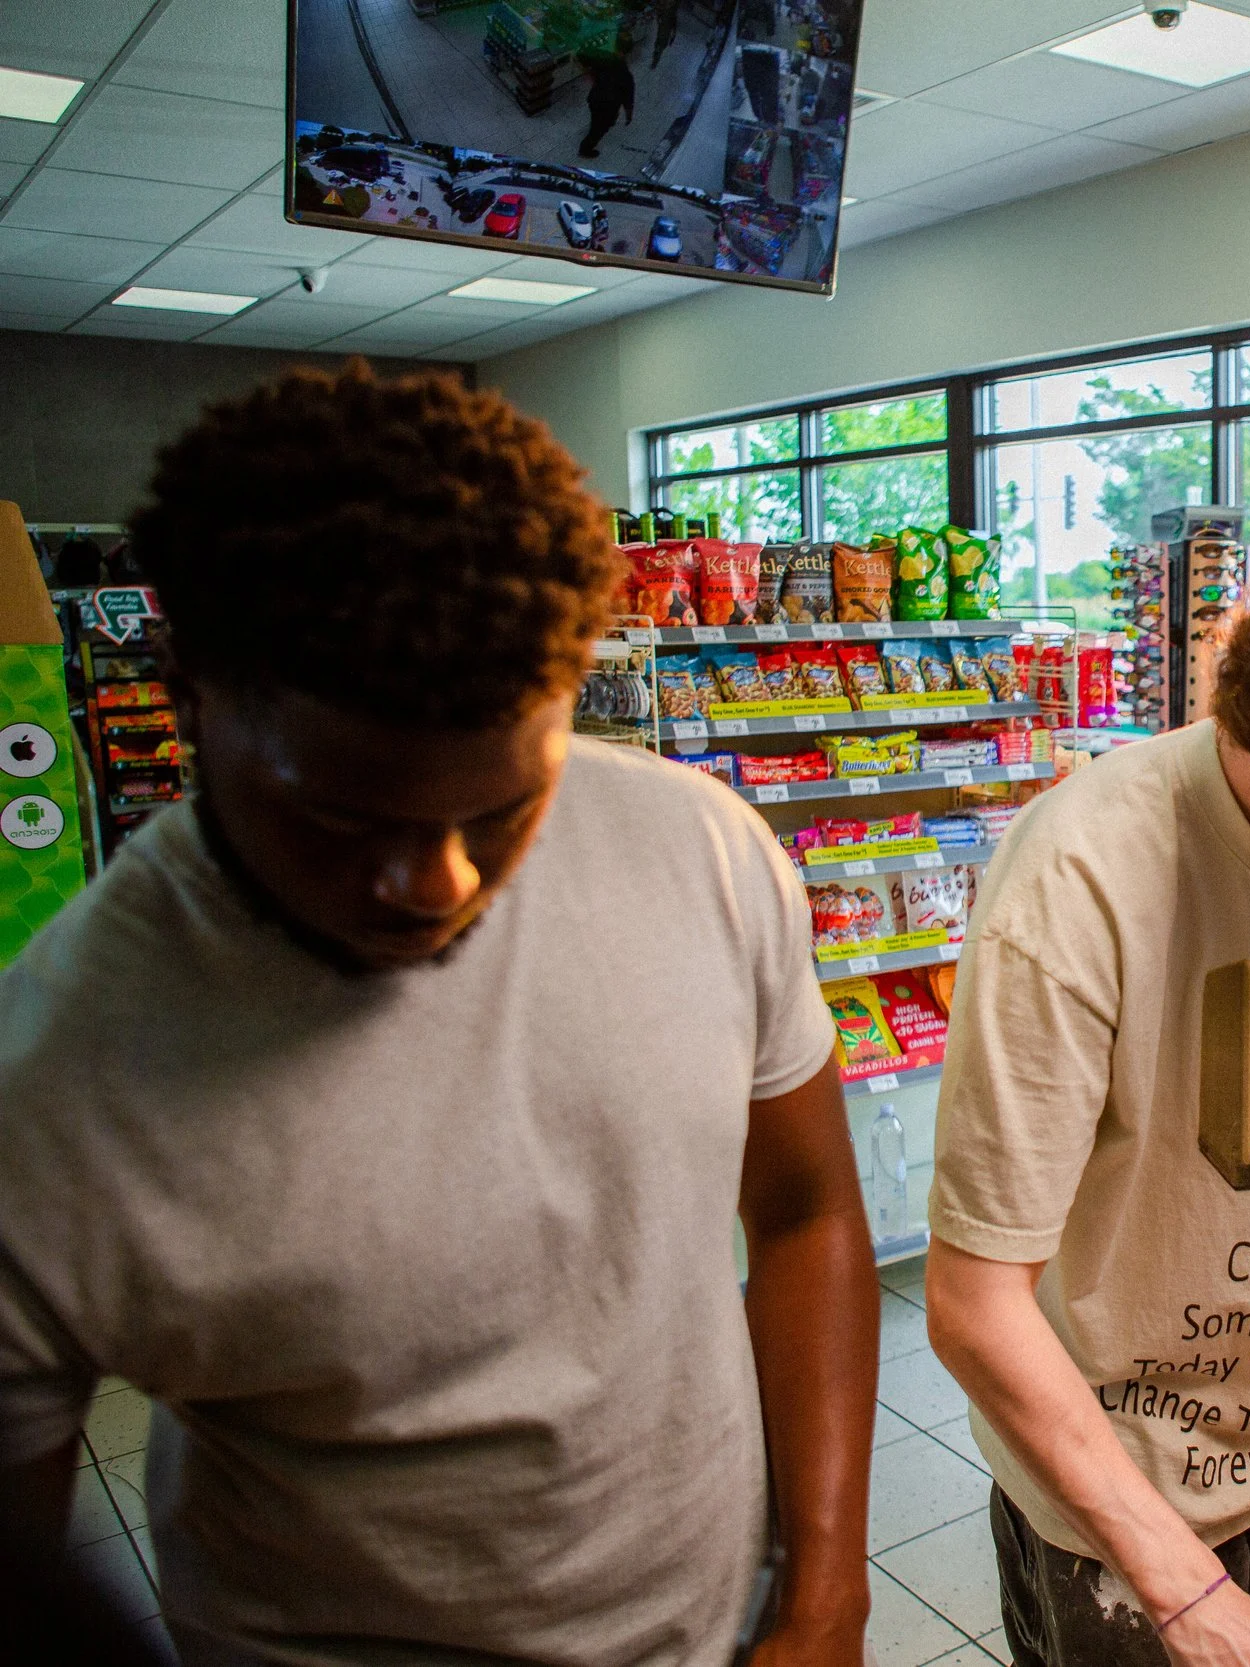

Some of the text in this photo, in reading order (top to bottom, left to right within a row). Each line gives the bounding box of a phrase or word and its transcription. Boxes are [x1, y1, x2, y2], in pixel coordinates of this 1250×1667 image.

[706, 555, 760, 576] Kettle
[785, 553, 832, 575] Kettle
[844, 558, 892, 577] Kettle
[873, 586, 891, 594] GOU
[841, 759, 892, 772] Butterfinger
[892, 1010, 936, 1026] PROTEIN
[896, 1003, 921, 1015] HIGH
[845, 1055, 909, 1076] VACADILLOS
[1133, 1354, 1241, 1382] Today
[1100, 1379, 1222, 1433] Change
